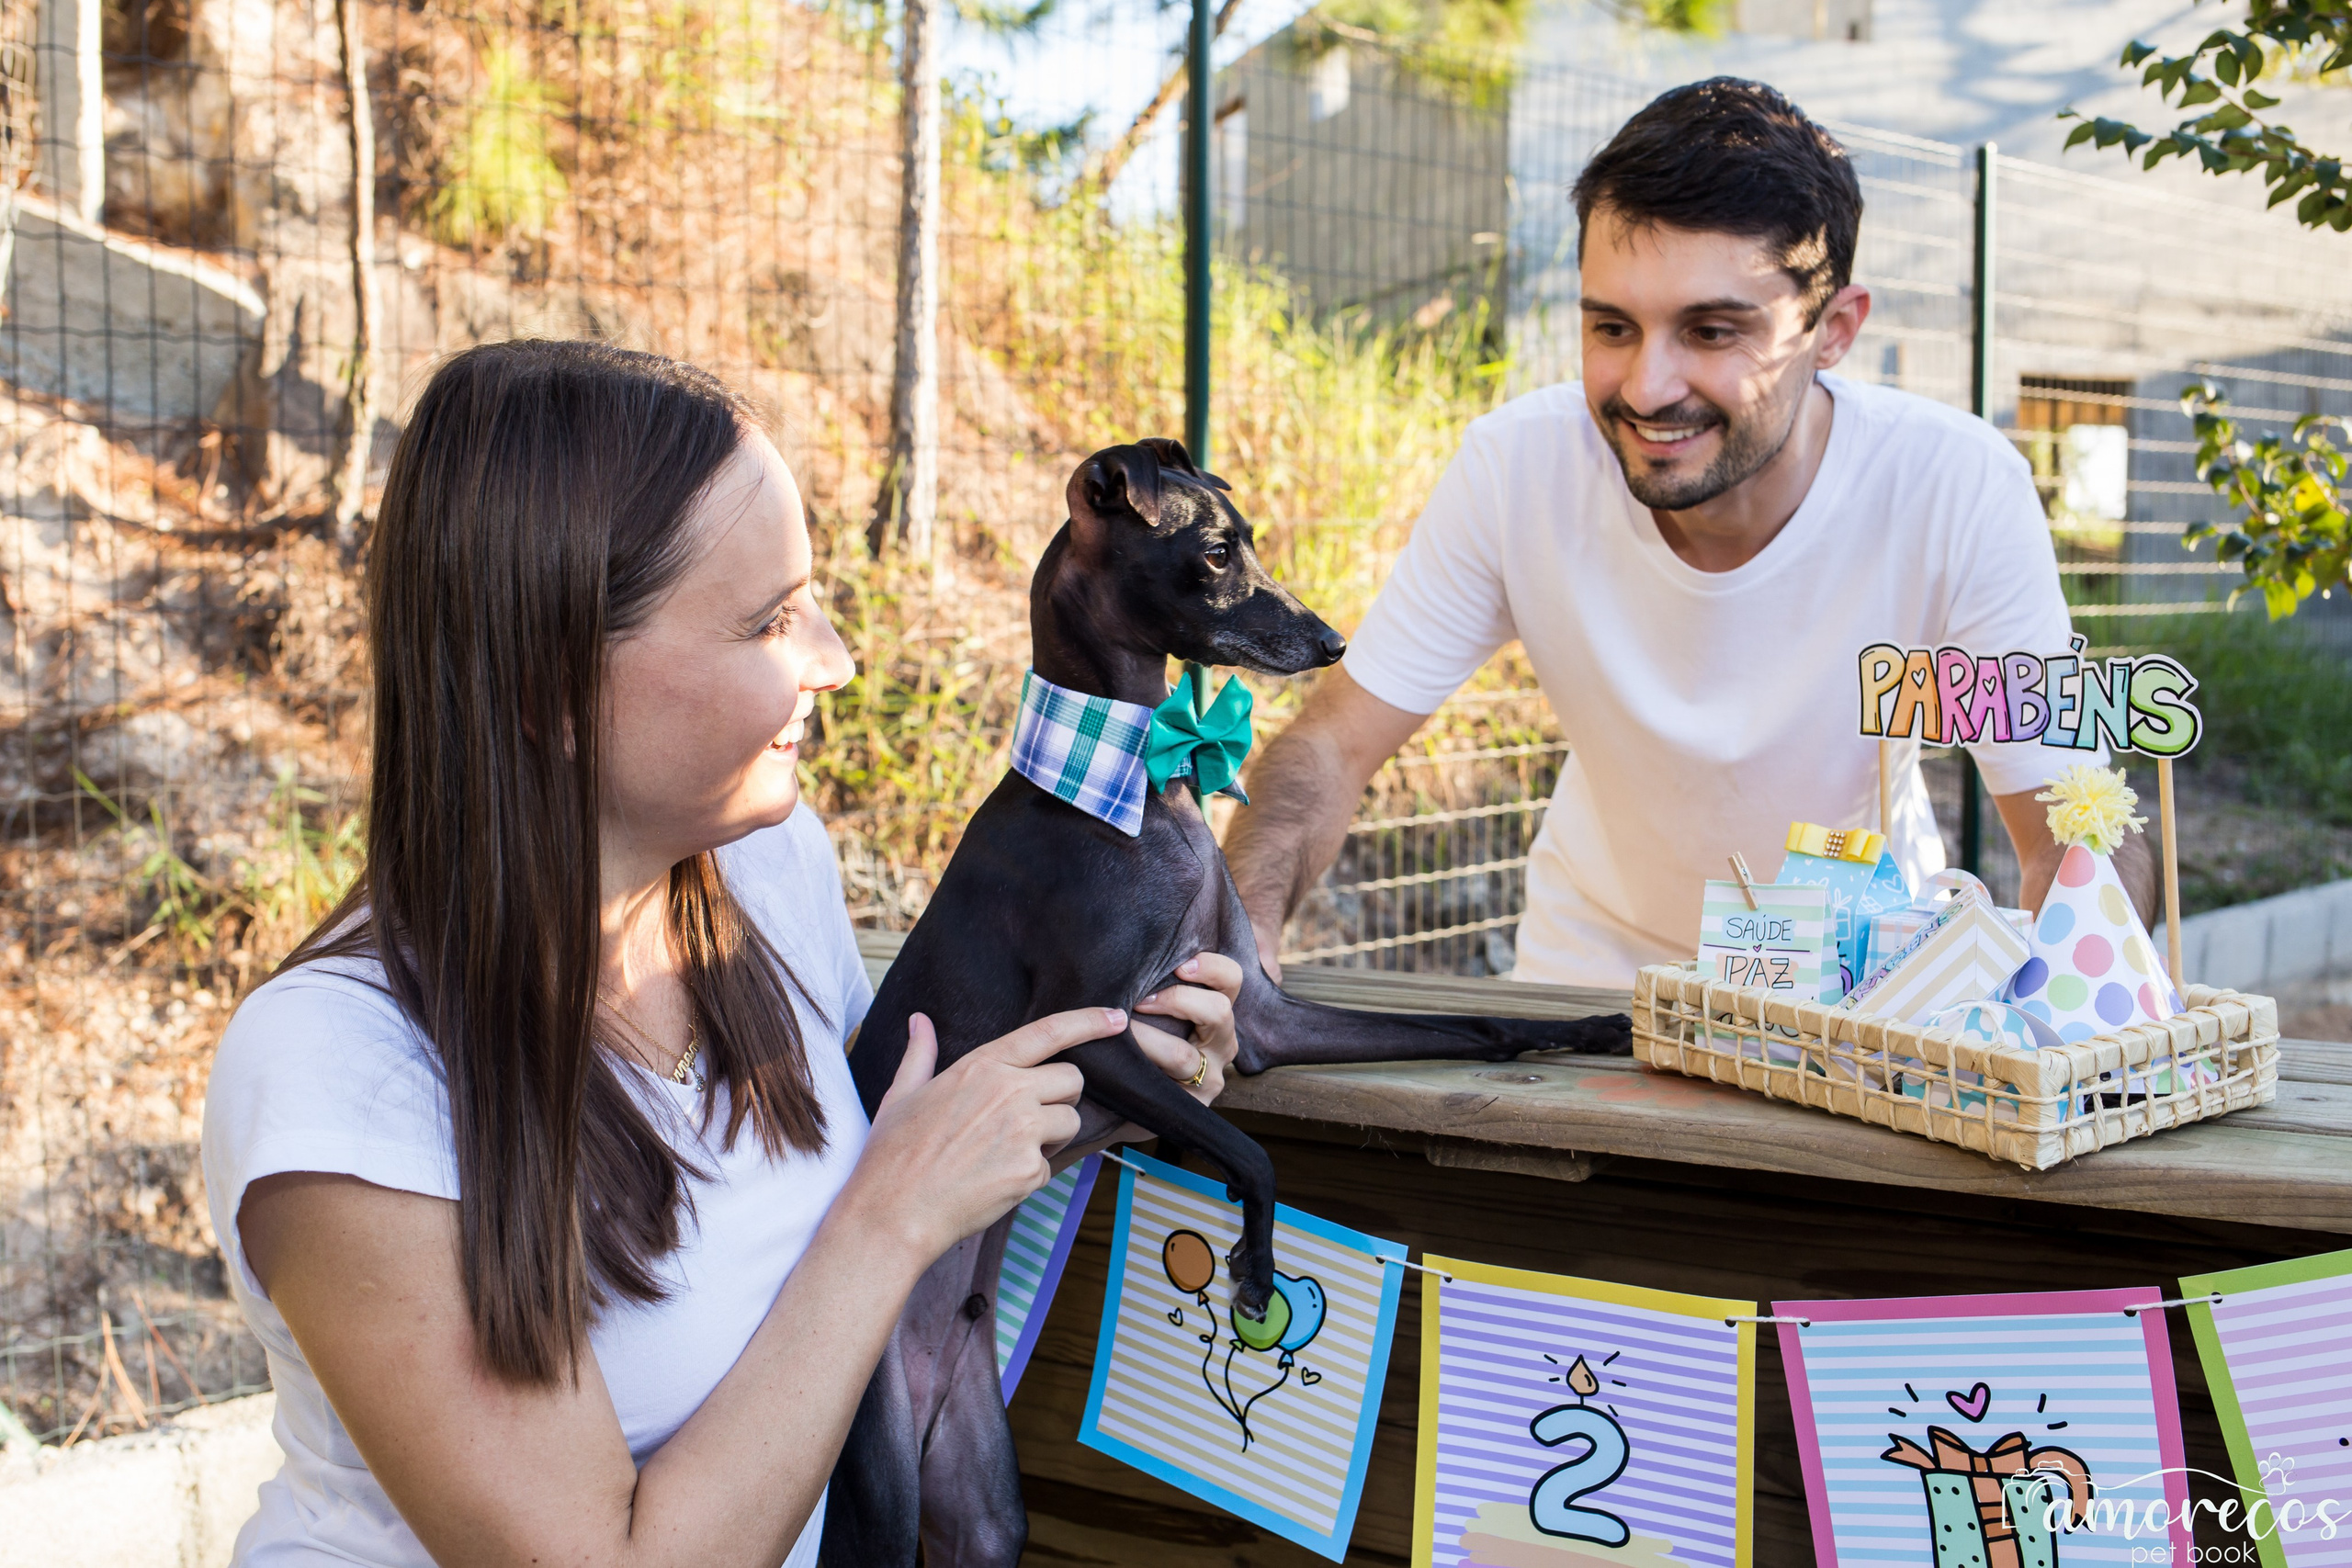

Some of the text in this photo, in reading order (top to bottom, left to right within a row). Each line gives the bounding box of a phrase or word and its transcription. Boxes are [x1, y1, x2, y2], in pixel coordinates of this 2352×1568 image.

[1858, 637, 2199, 756] PARABÉNS
[1726, 914, 1792, 942] SAÚDE
[1724, 955, 1794, 989] PAZ
[1529, 1404, 1631, 1549] 2
